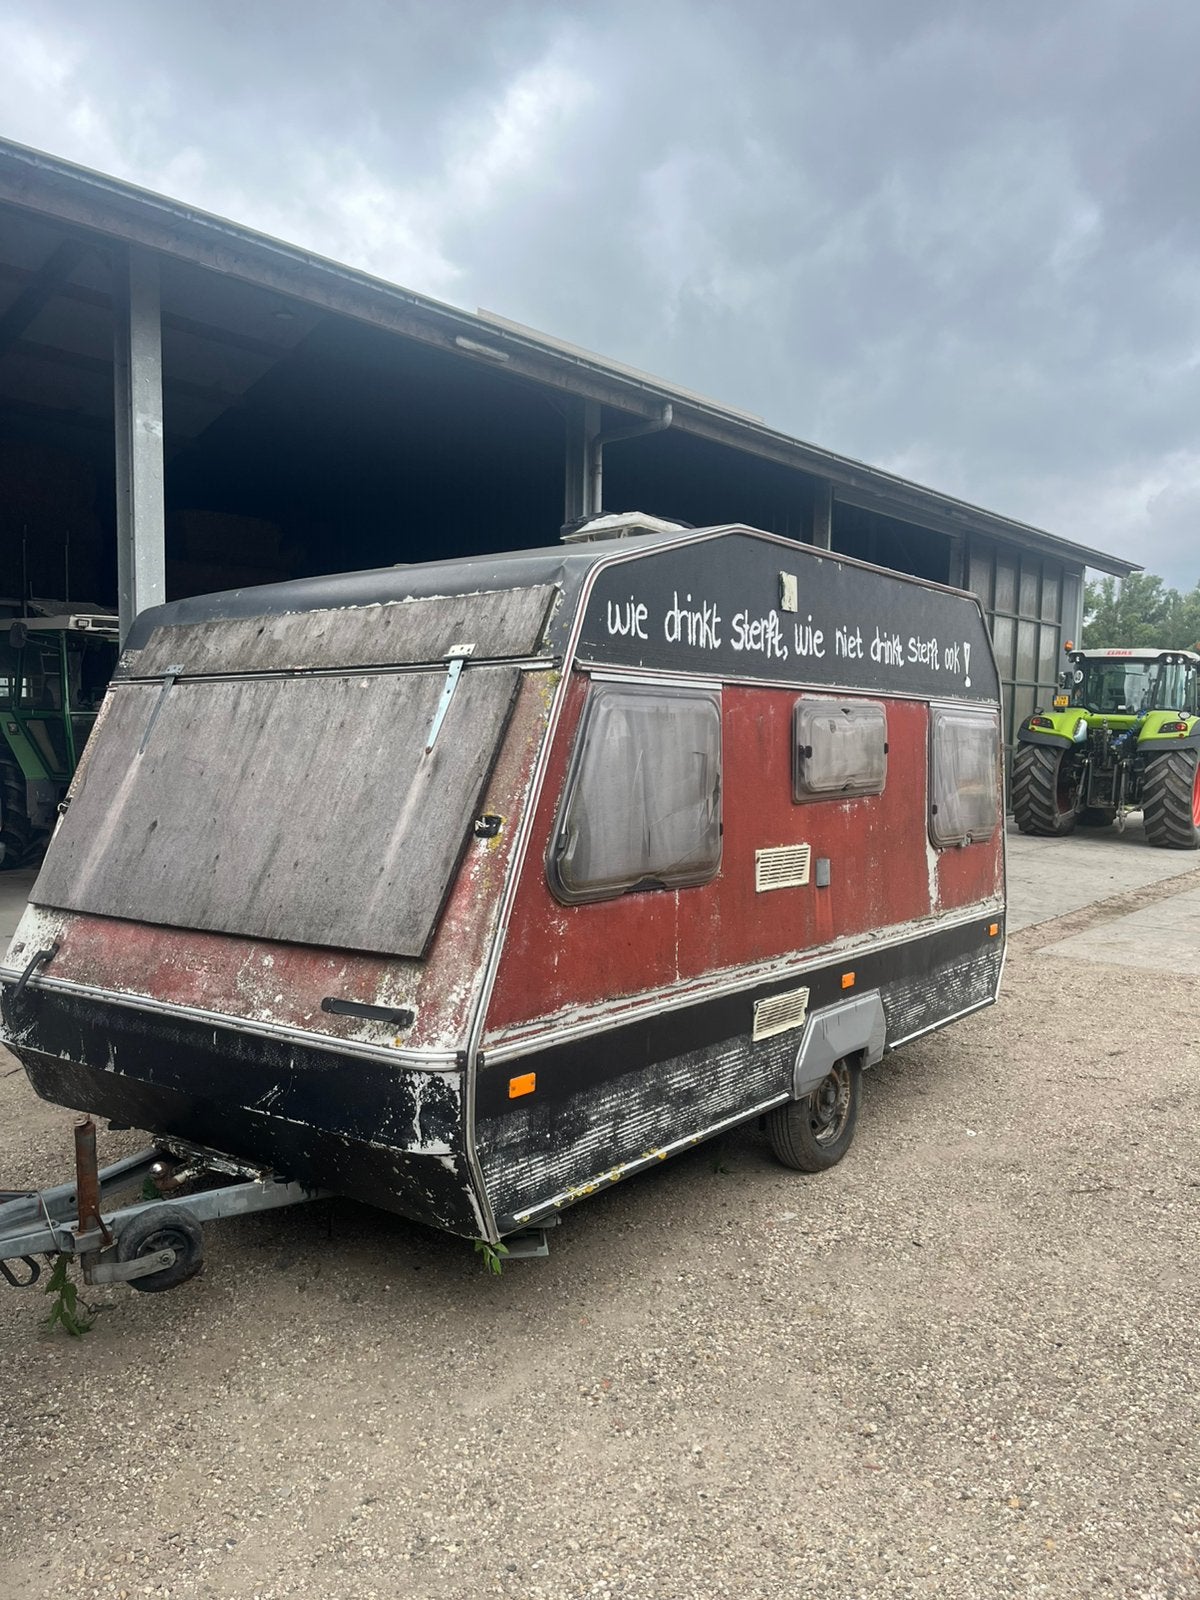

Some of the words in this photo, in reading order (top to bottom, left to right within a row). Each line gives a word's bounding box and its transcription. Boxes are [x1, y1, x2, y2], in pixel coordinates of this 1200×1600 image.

[664, 590, 722, 650] drinkt
[835, 625, 864, 659] niet
[870, 626, 905, 667] drinkt
